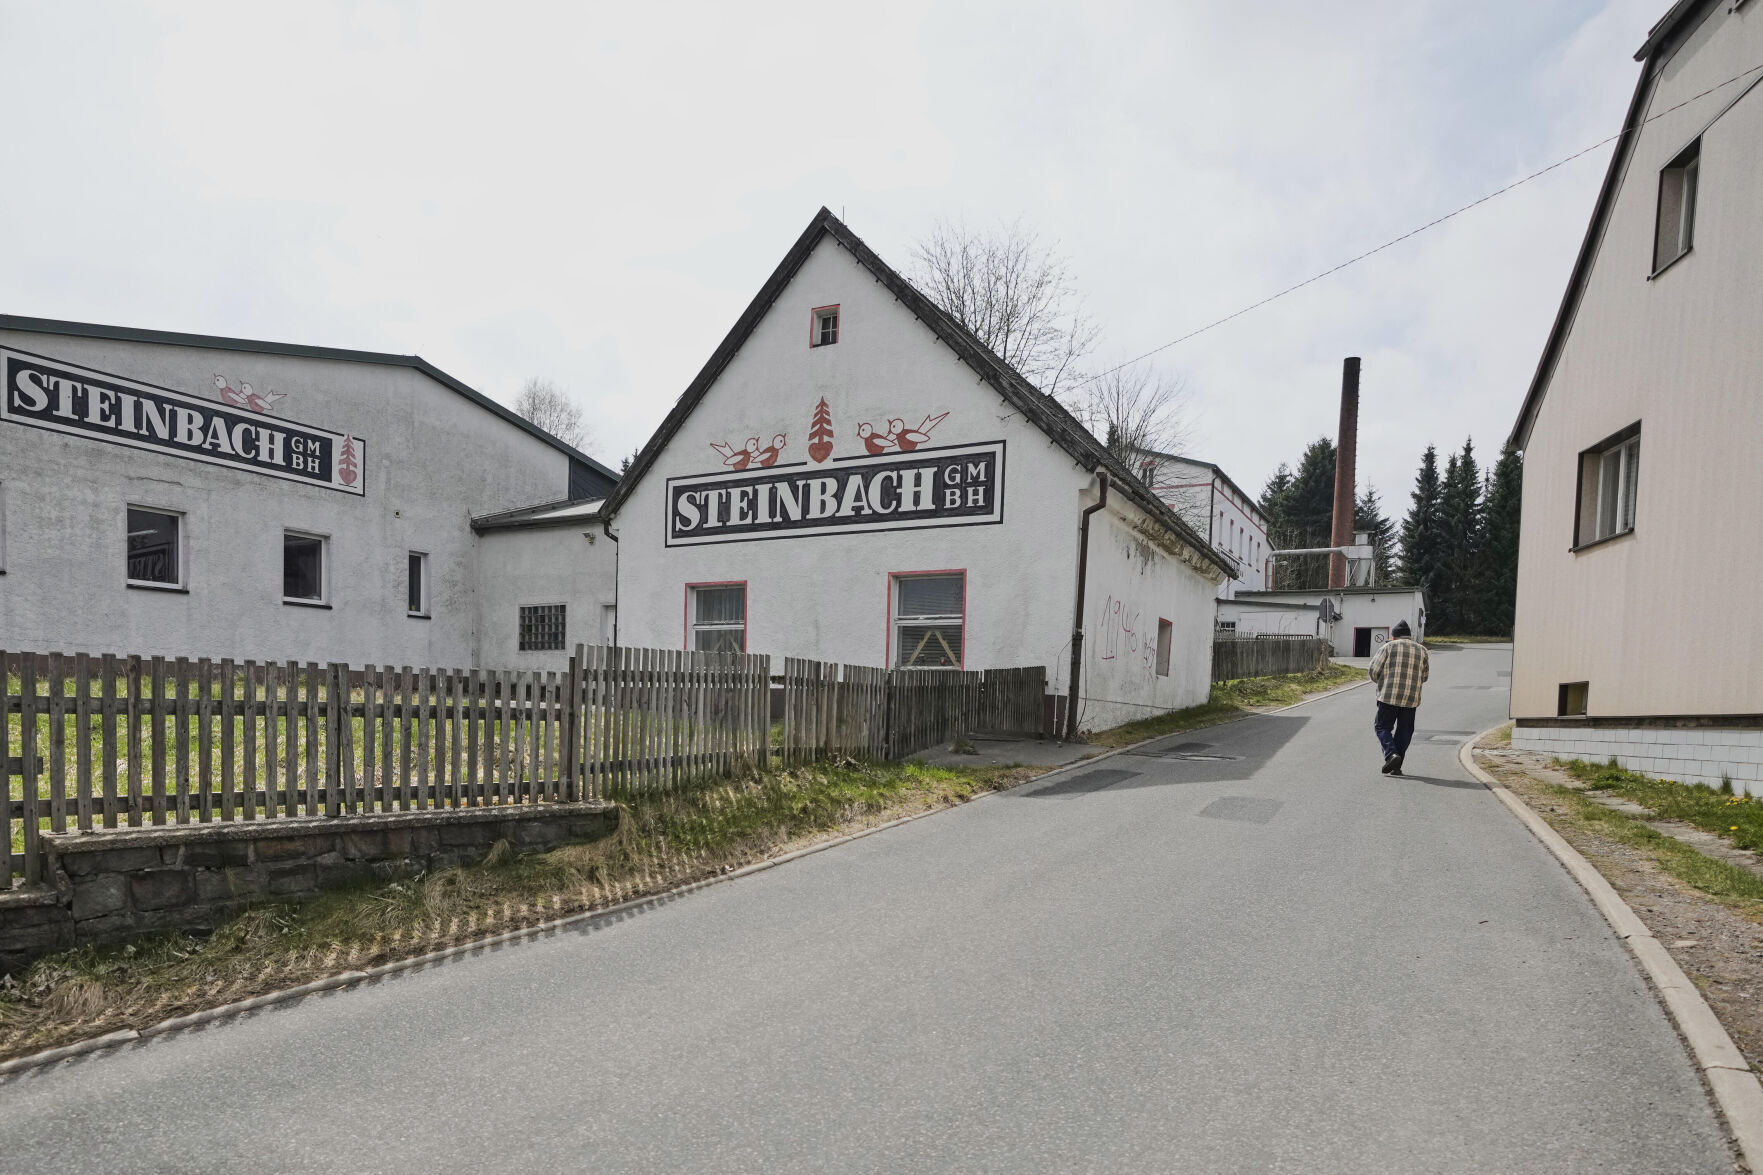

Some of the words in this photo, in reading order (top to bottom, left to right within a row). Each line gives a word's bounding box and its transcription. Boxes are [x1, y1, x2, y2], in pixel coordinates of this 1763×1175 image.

[14, 369, 286, 466] STEINBACH
[291, 436, 321, 456] GM
[291, 454, 321, 474] BH
[944, 461, 987, 486] GM
[675, 465, 939, 532] STEINBACH
[943, 486, 986, 510] BH
